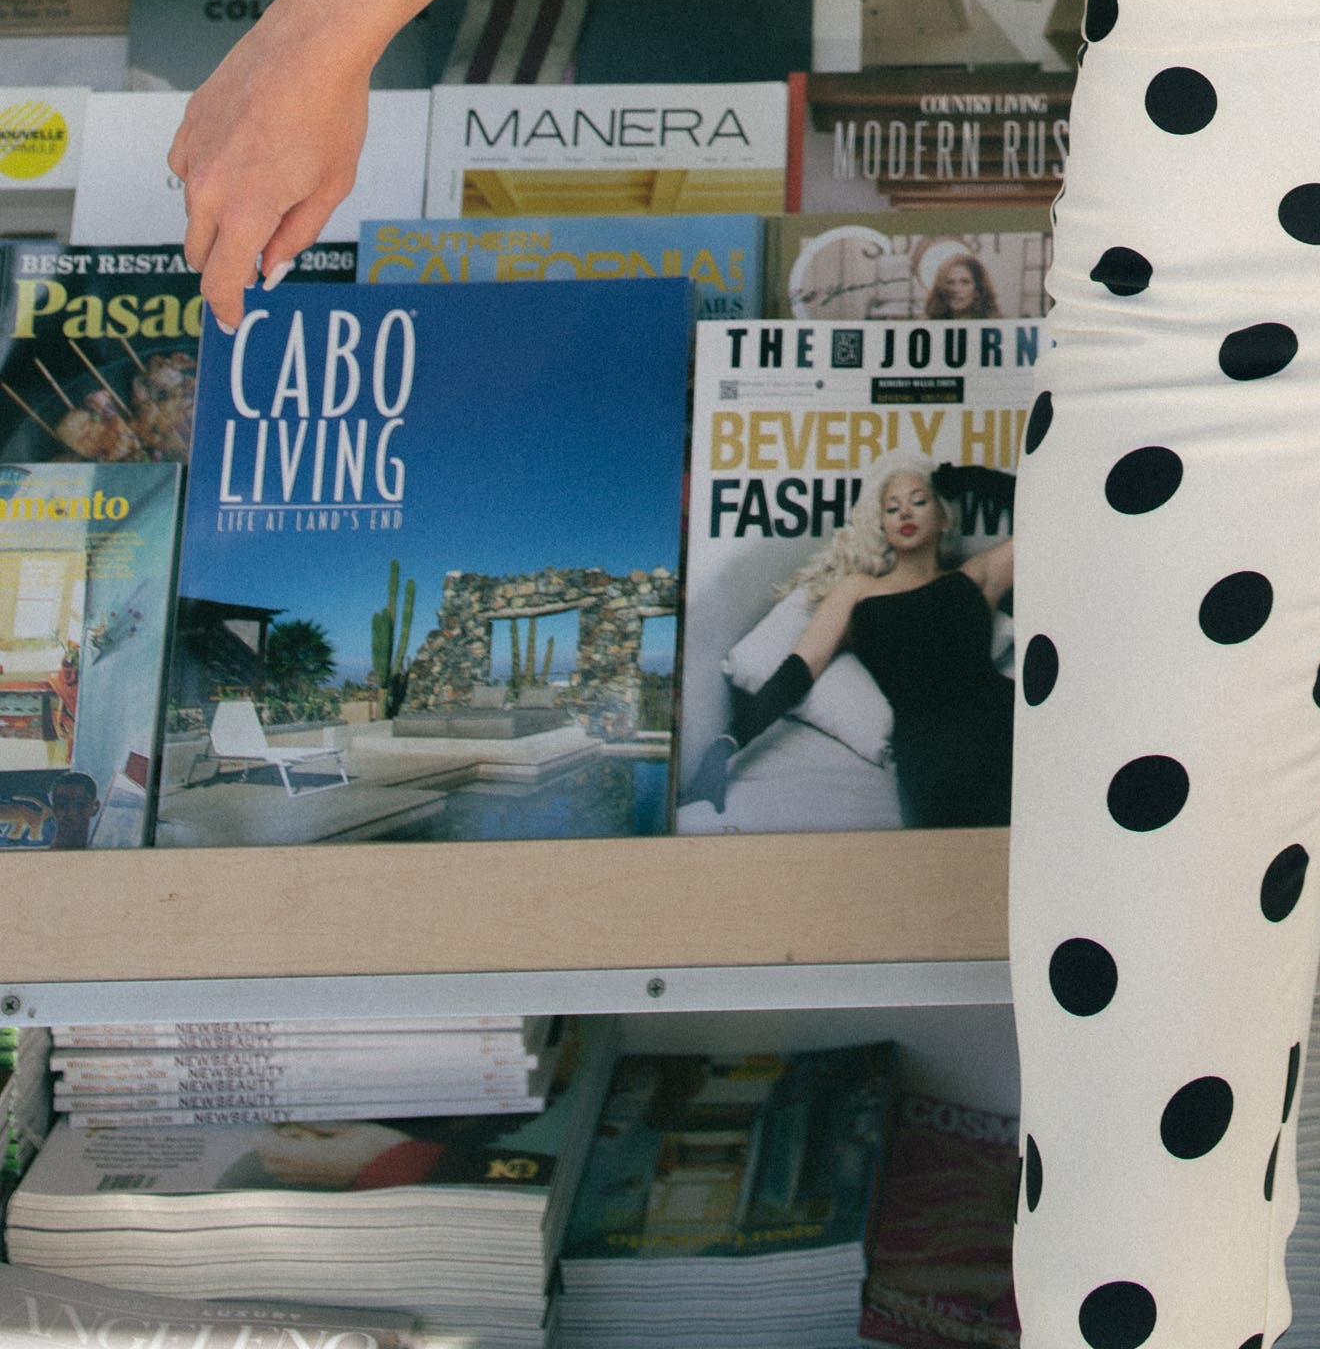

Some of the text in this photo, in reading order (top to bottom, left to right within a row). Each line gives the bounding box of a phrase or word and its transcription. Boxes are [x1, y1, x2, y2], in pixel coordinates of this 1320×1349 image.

[464, 108, 752, 148] MANERA
[832, 120, 981, 181] MODERN
[375, 226, 552, 254] SOUTHERN
[21, 253, 93, 275] BEST
[231, 308, 416, 420] CABO
[726, 328, 815, 369] THE
[219, 418, 405, 503] LIVING
[216, 508, 404, 533] LIFE AT LAND'S END
